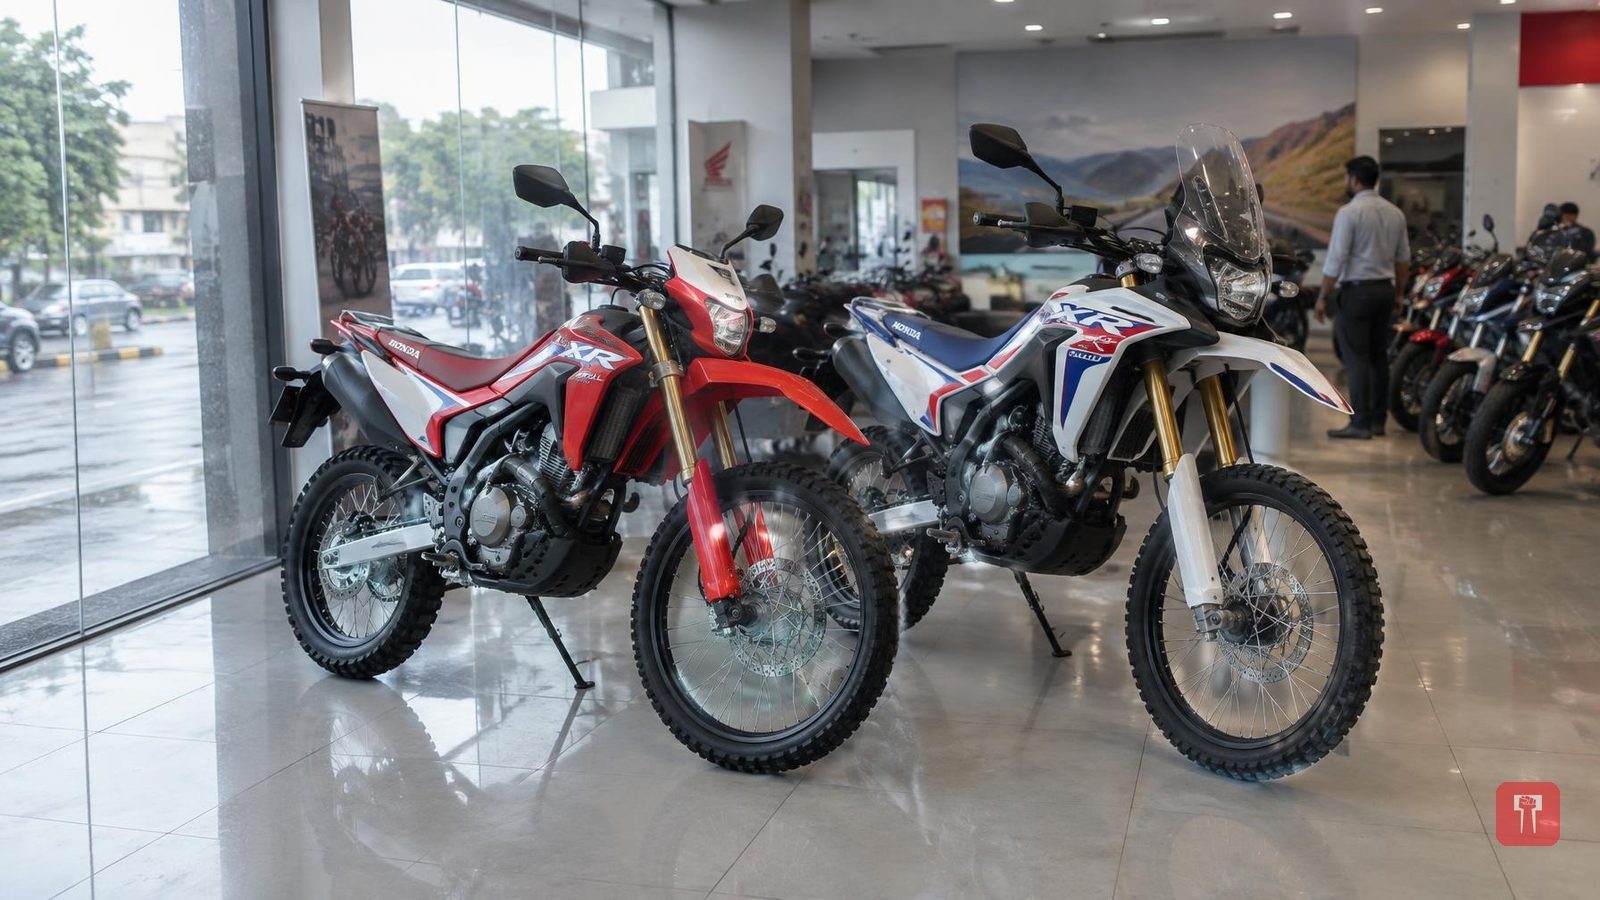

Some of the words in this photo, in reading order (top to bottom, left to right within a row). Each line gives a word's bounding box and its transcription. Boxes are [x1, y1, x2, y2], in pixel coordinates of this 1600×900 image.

[892, 321, 921, 340] HONDA
[1048, 304, 1133, 338] XR
[389, 340, 420, 359] HONDA
[560, 341, 627, 370] XR
